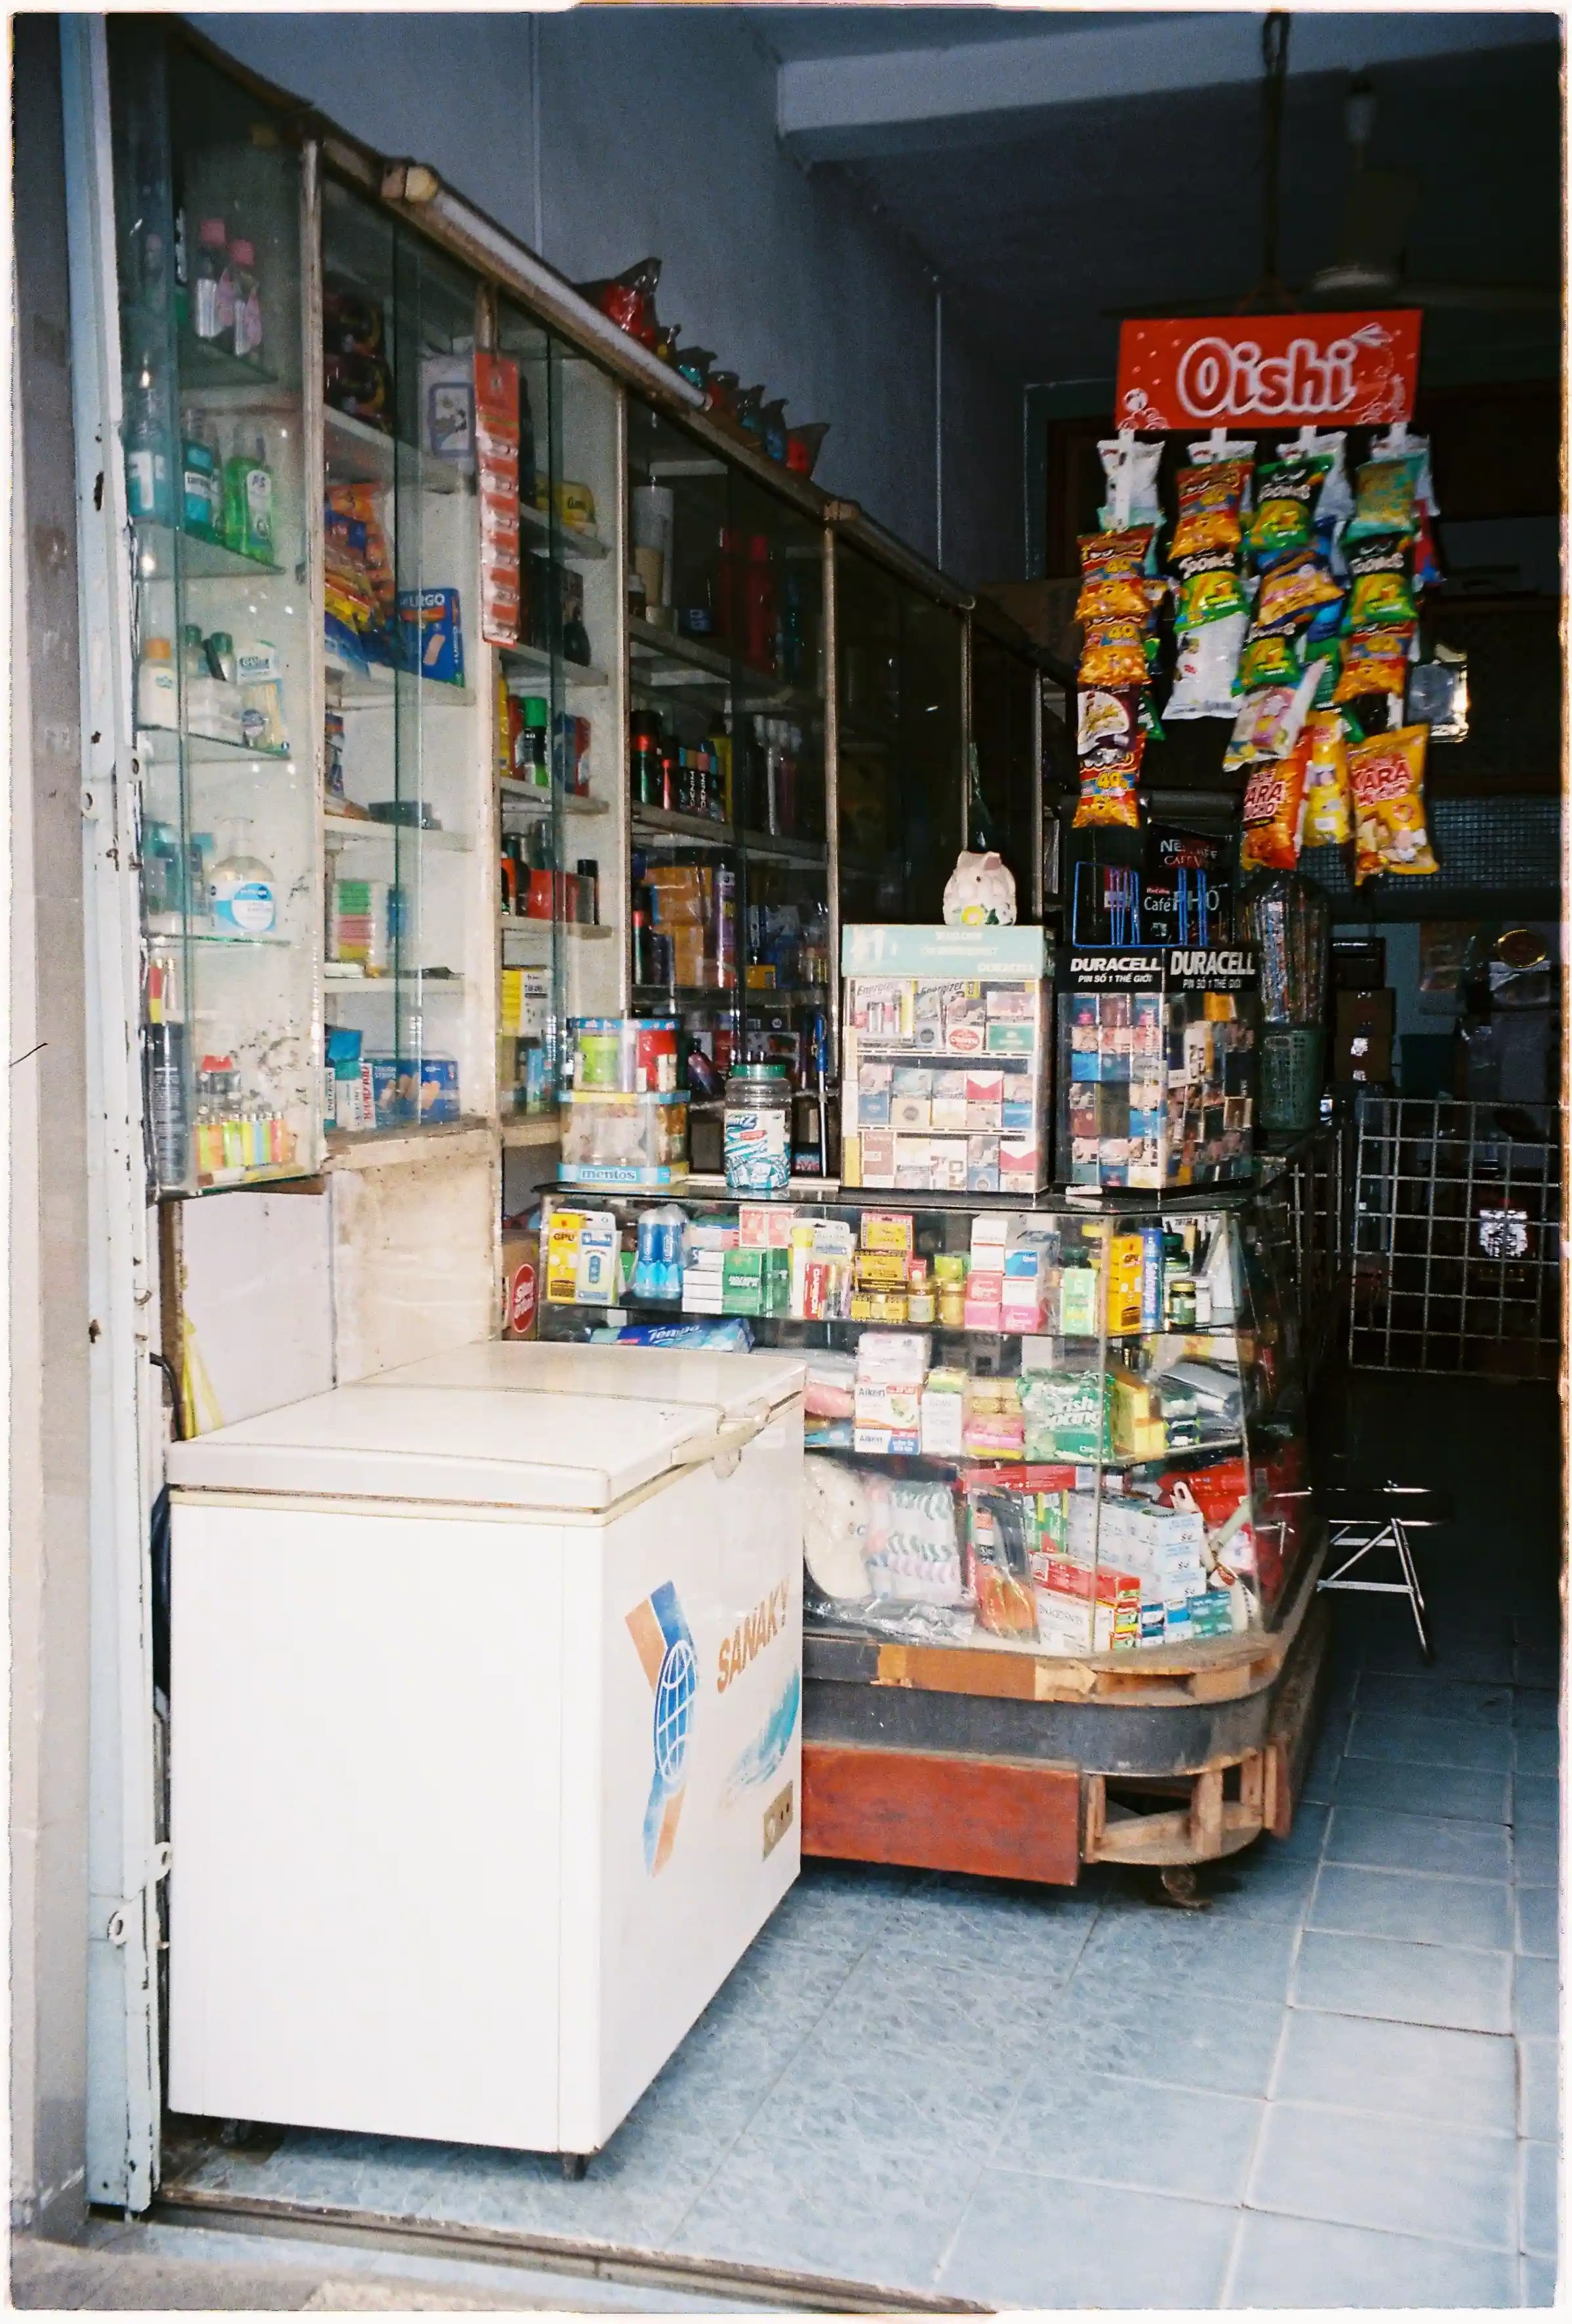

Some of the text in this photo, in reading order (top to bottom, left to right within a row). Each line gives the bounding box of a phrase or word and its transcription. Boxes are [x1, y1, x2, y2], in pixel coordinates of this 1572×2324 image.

[1178, 337, 1356, 418] Oishi
[1070, 958, 1161, 971] DURACELL
[1170, 951, 1256, 975] DURACELL
[1094, 972, 1107, 983] SỐ
[582, 1170, 635, 1180] mentos
[554, 1233, 575, 1242] GPU
[648, 1324, 700, 1341] Tempo
[858, 1387, 885, 1397] Aiken
[859, 1435, 883, 1443] Aiken
